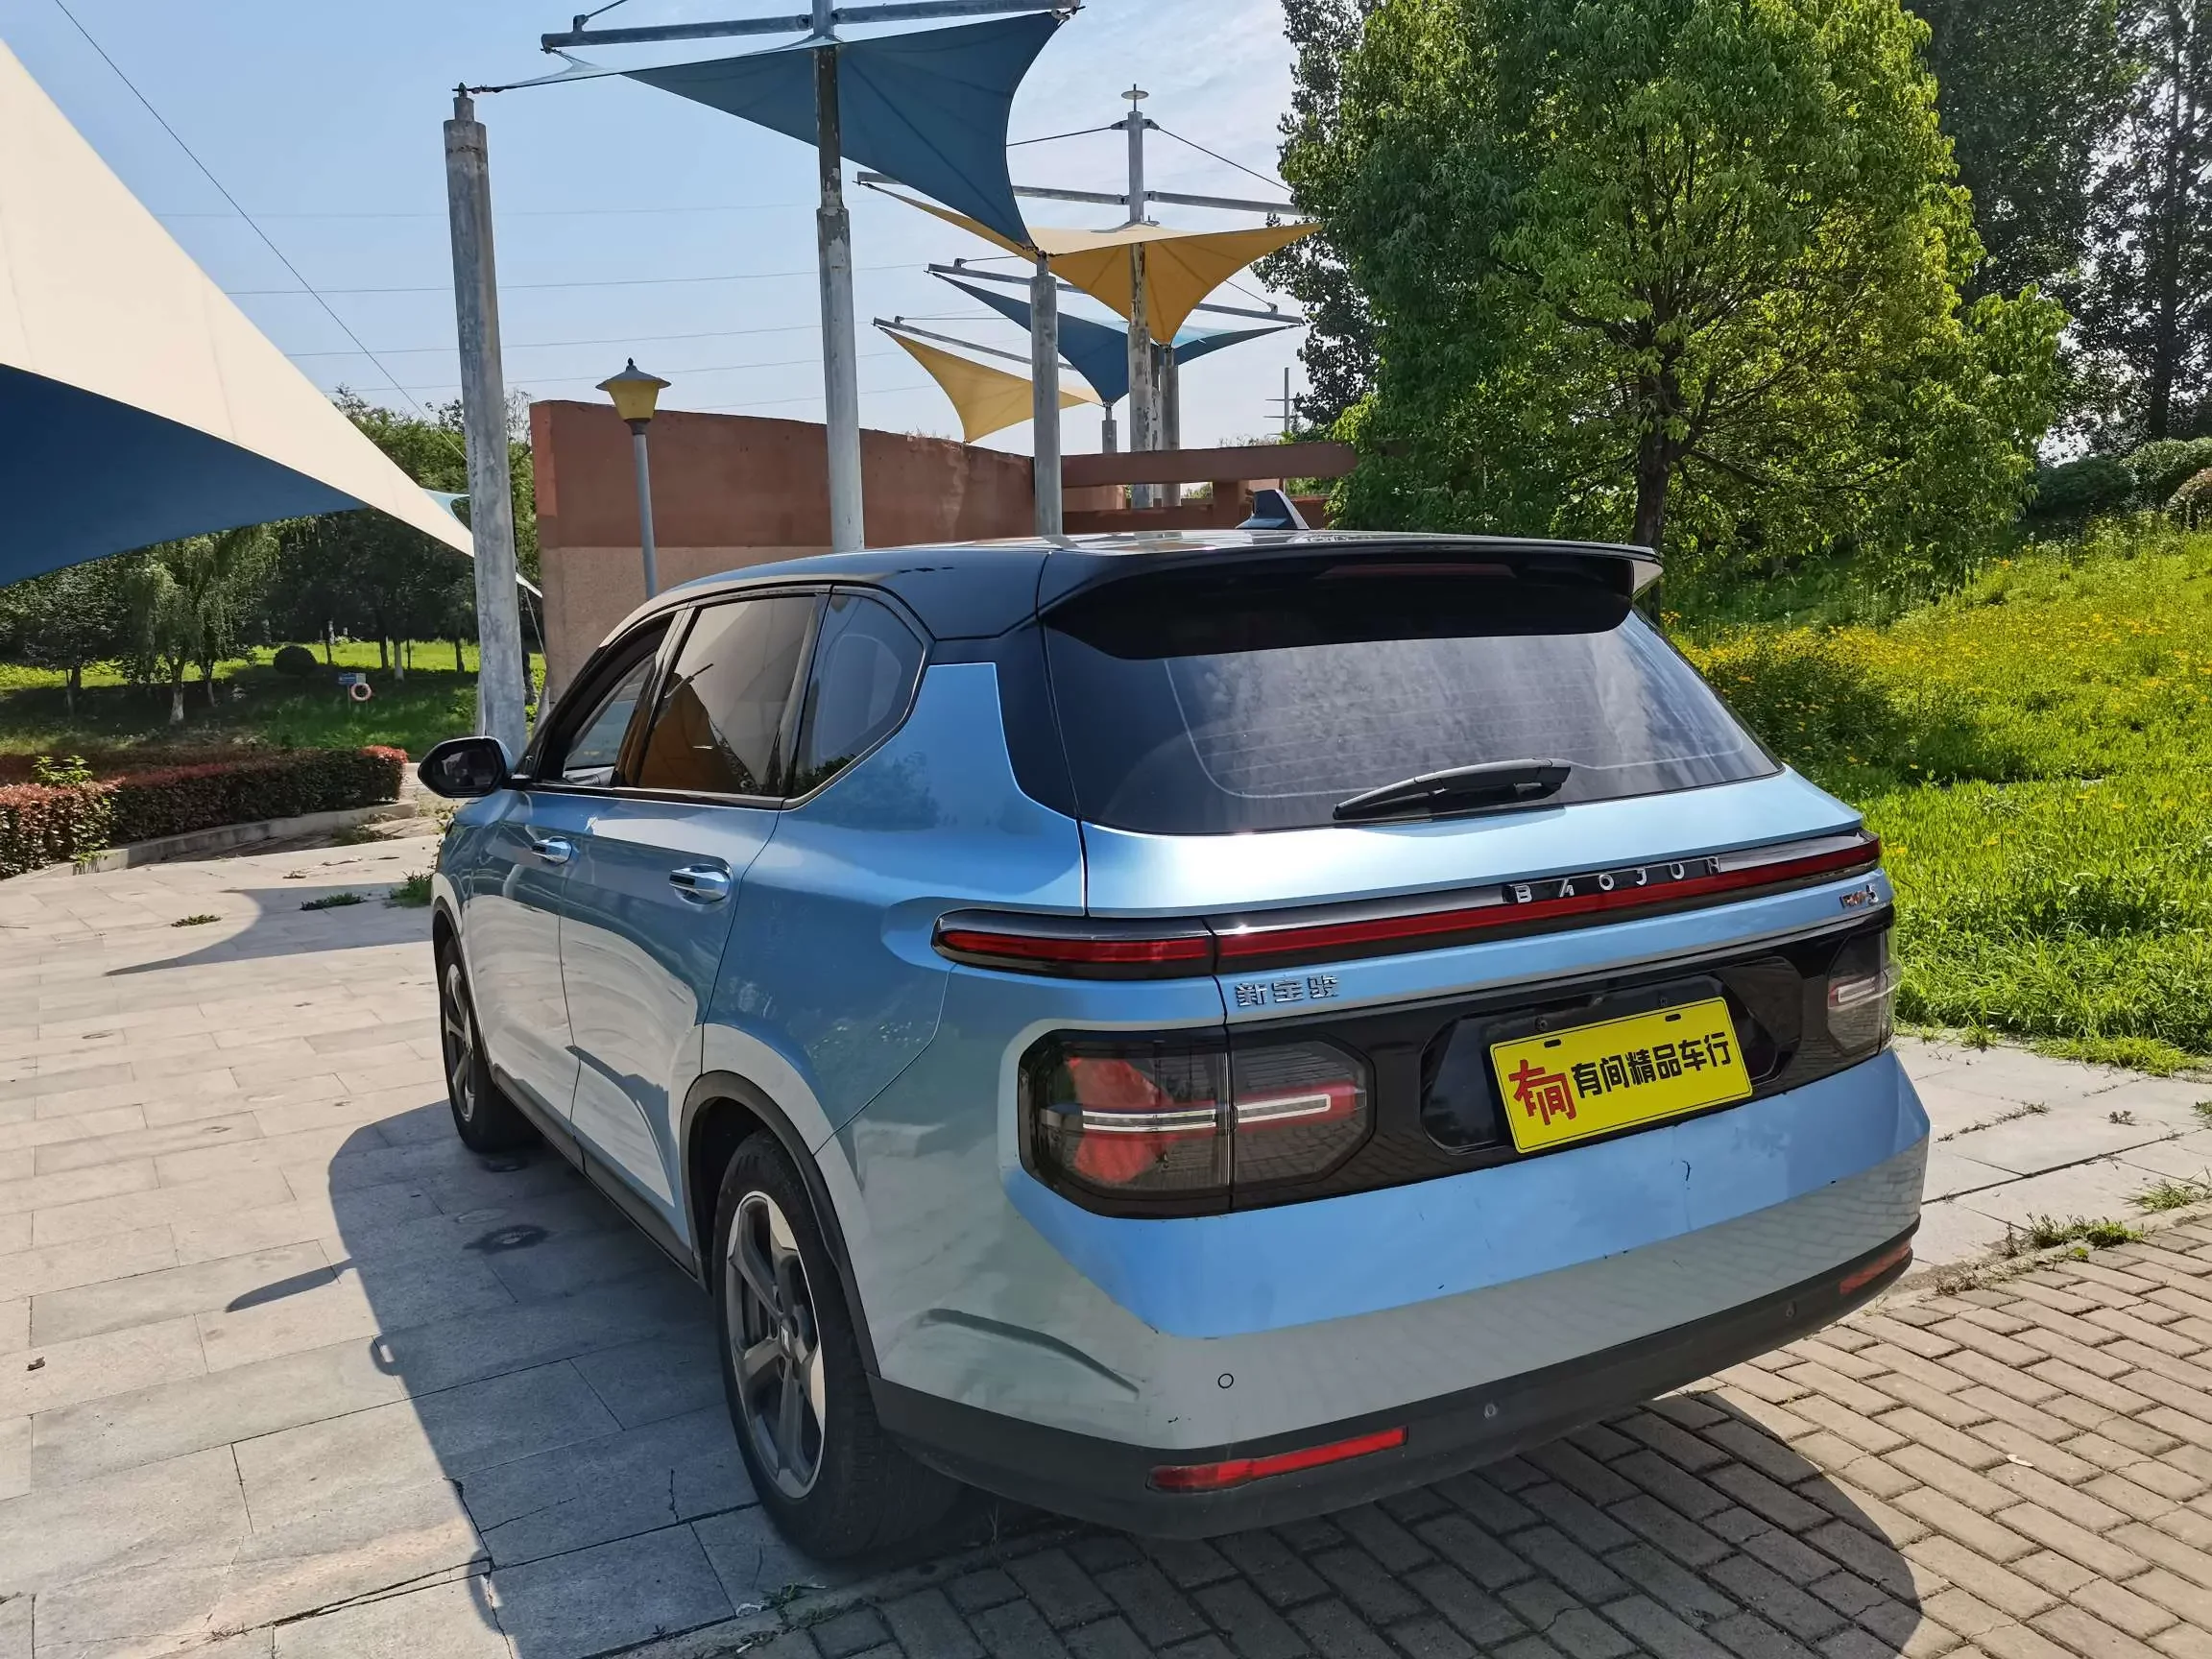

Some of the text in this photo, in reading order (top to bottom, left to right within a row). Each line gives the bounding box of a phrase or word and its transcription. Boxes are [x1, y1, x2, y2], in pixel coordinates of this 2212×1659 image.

[1514, 856, 1721, 904] BAOJUN
[1235, 974, 1340, 1007] 新宝骏
[1570, 1030, 1733, 1099] 有间精品车行
